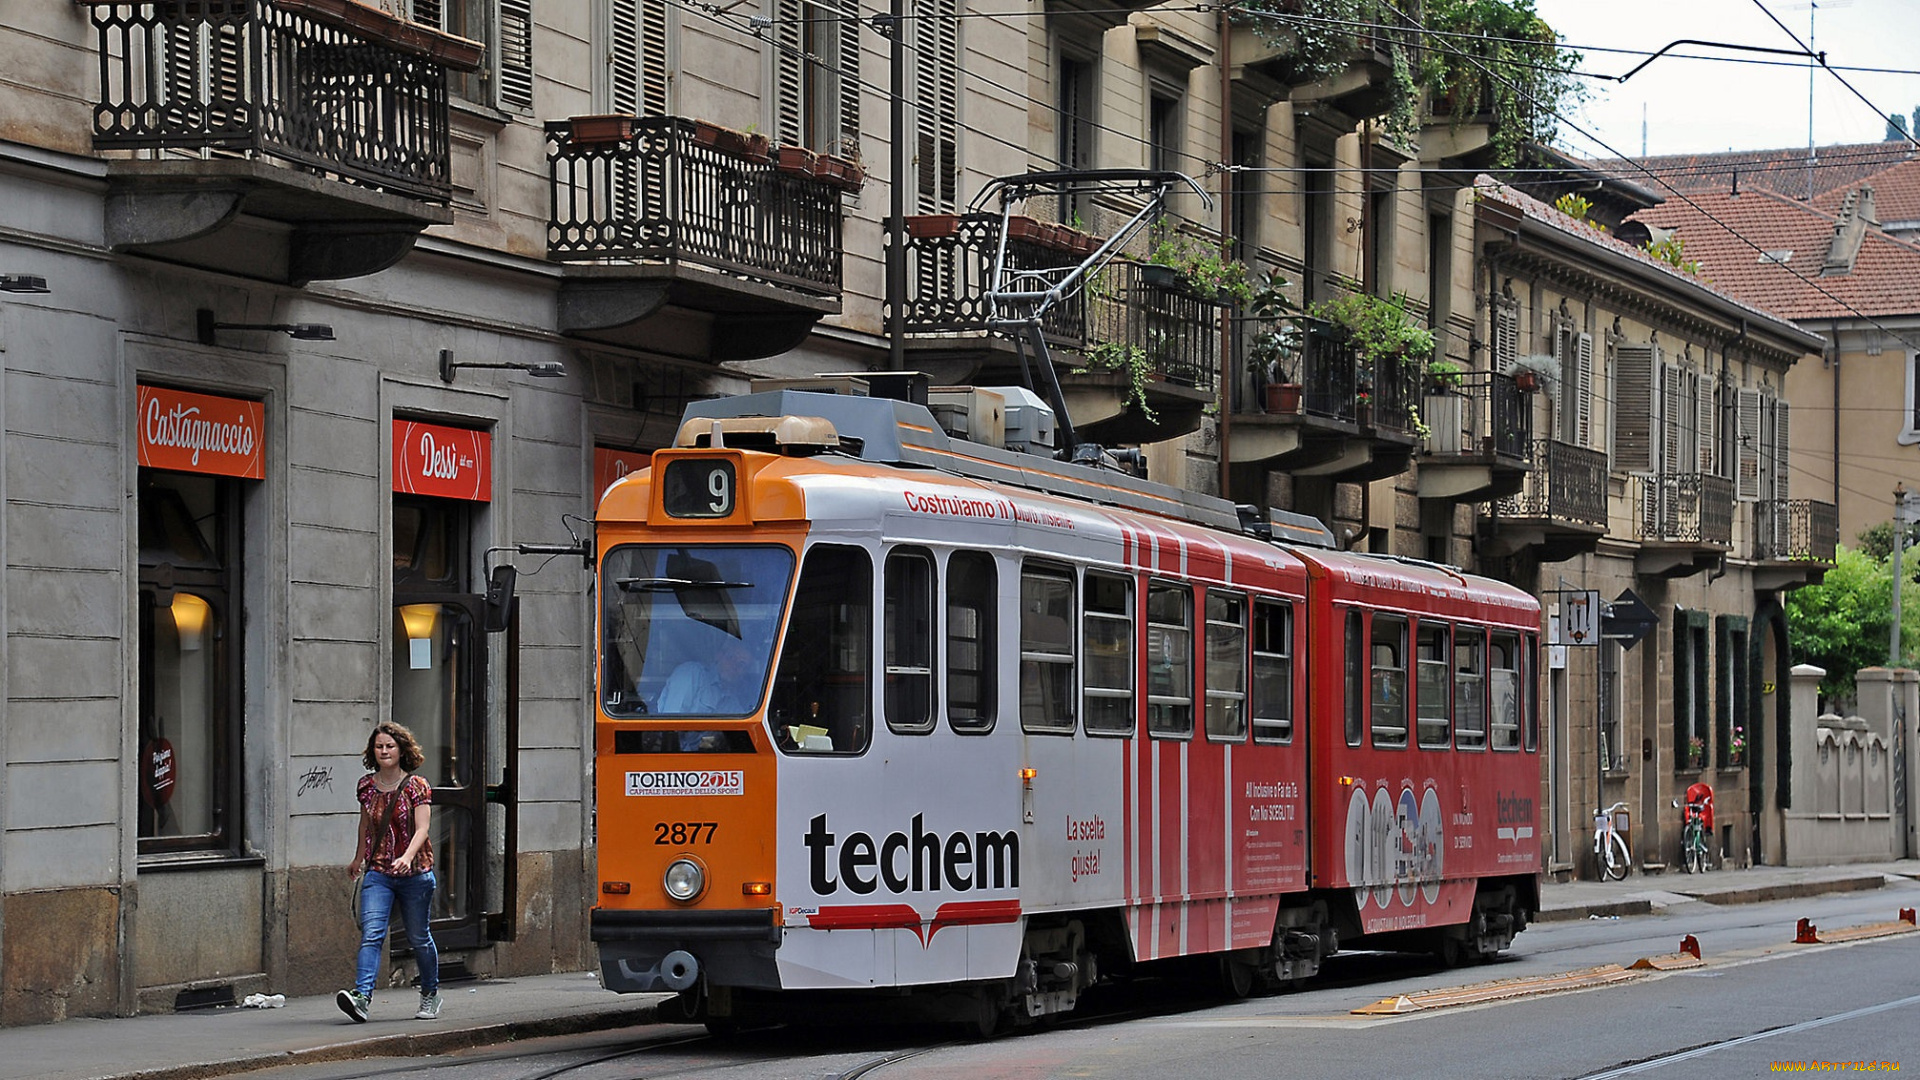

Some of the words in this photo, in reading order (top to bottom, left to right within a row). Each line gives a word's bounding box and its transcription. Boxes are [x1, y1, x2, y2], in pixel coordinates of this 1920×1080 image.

[147, 397, 254, 466] Castagnaccio
[420, 432, 458, 480] Dessì
[708, 468, 729, 513] 9
[904, 491, 995, 519] Costruiamo
[996, 500, 1009, 519] il
[1497, 790, 1533, 824] techem
[654, 822, 718, 845] 2877
[1066, 815, 1078, 841] La
[1079, 813, 1105, 840] scelta
[803, 812, 1020, 896] techem
[1071, 848, 1101, 883] giusta!
